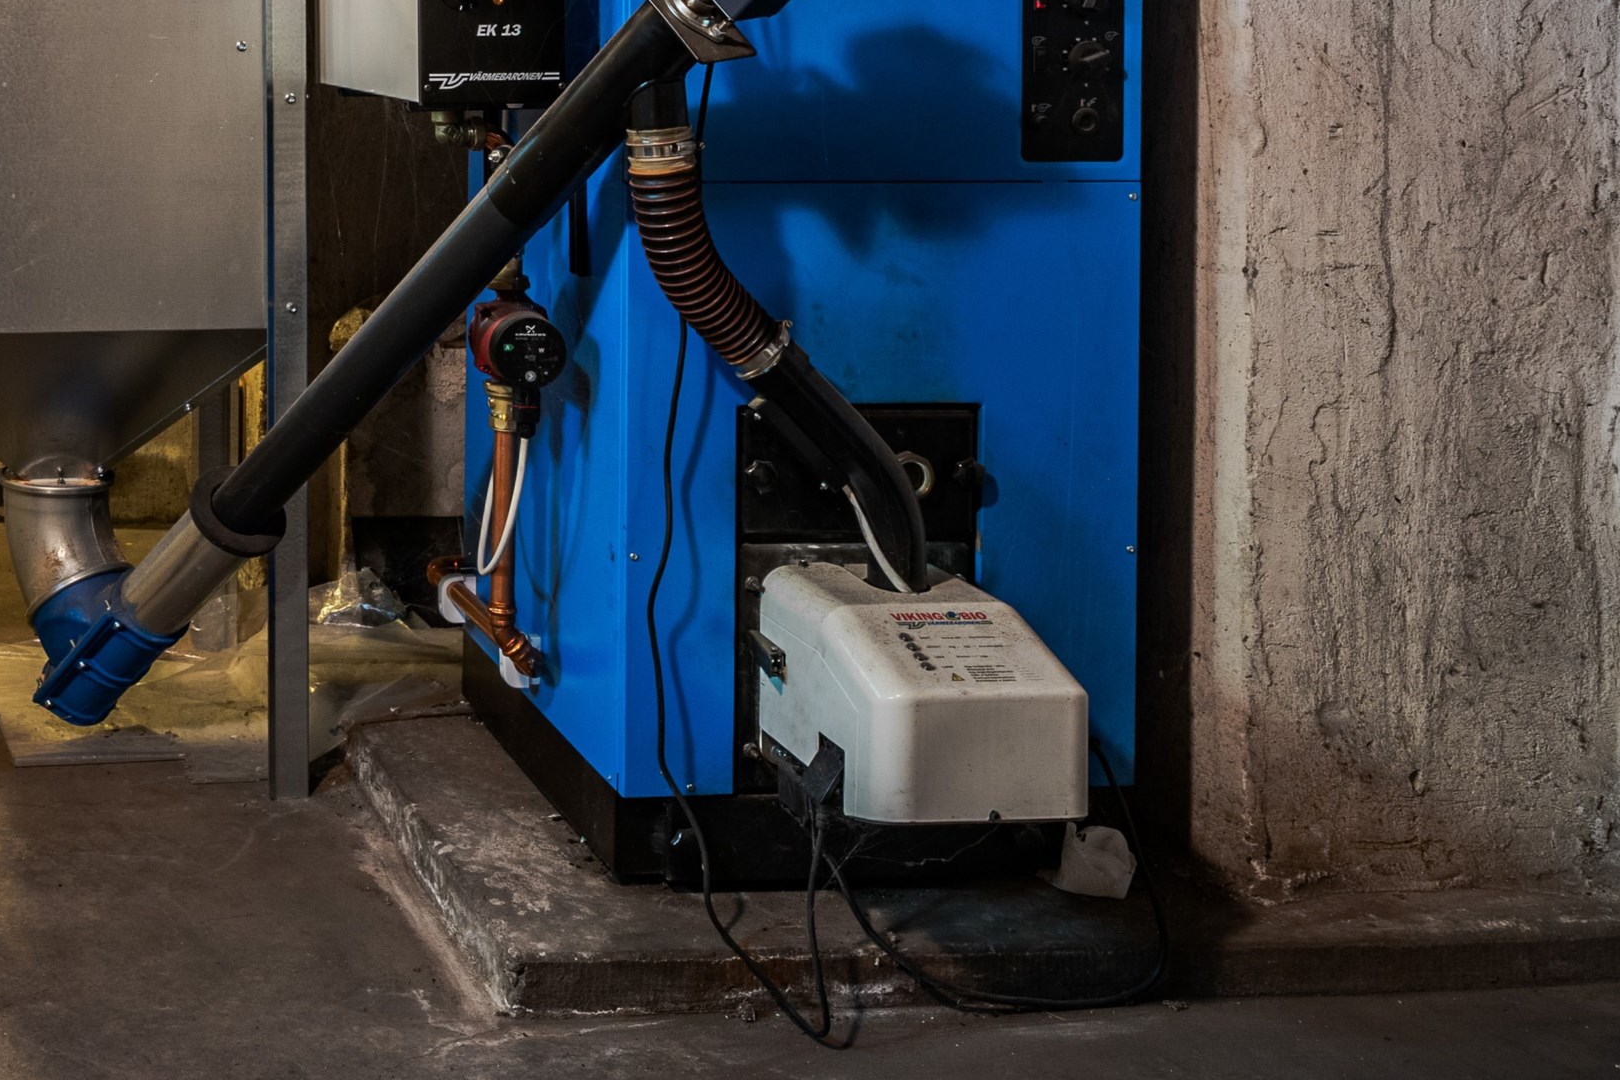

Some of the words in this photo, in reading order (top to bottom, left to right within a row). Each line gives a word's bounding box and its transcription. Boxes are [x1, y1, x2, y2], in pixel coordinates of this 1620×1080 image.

[476, 23, 498, 37] EK
[500, 23, 522, 37] 13
[468, 71, 544, 81] VÄRMEBARONEN
[890, 612, 944, 621] VIKING
[958, 612, 987, 620] BIO
